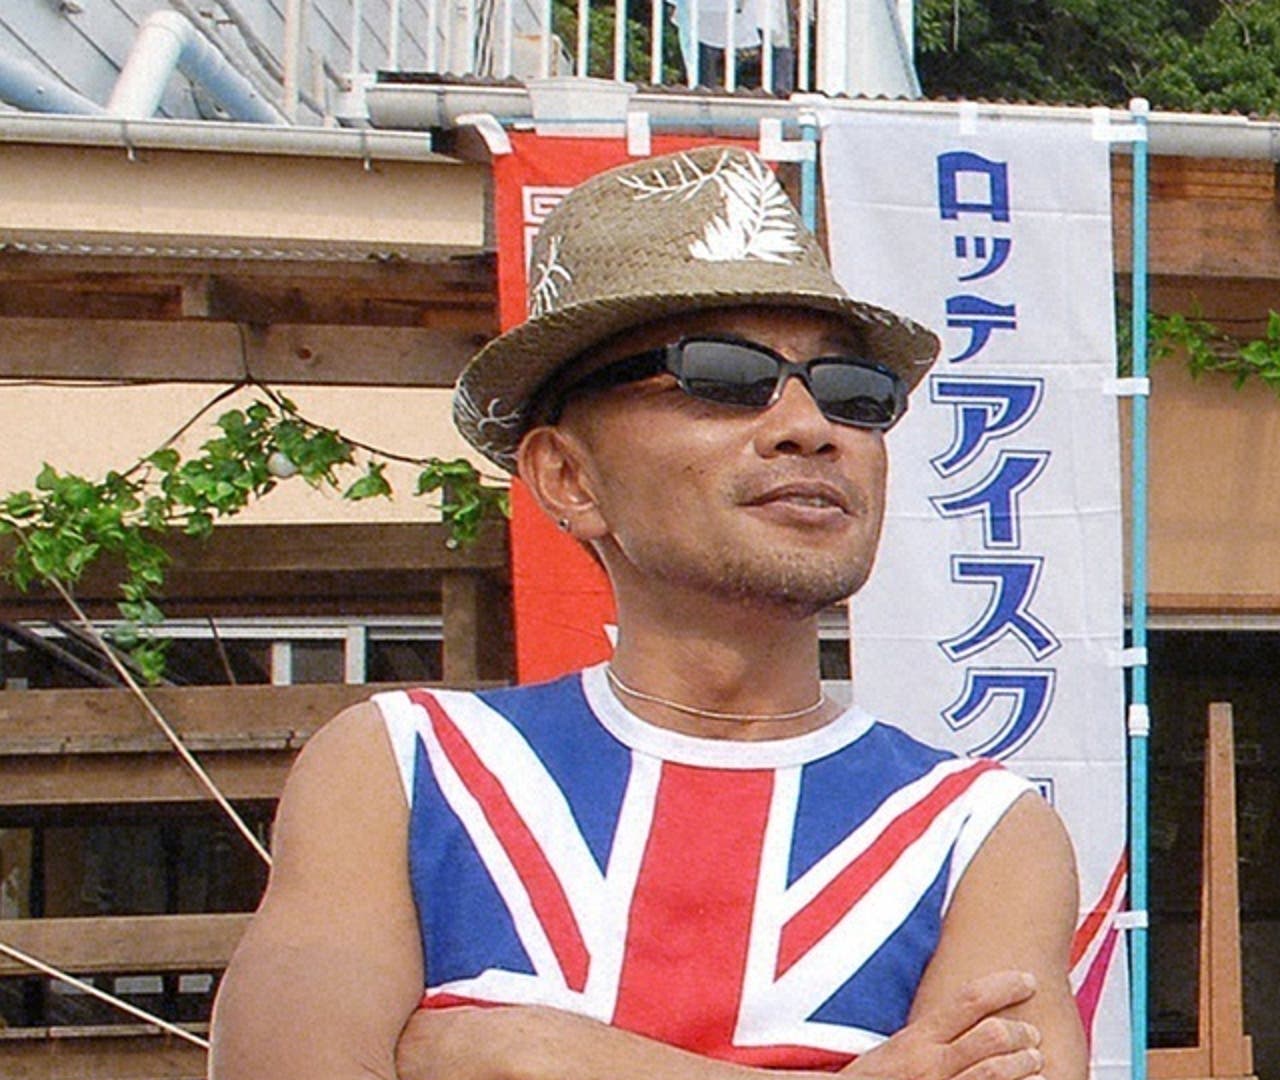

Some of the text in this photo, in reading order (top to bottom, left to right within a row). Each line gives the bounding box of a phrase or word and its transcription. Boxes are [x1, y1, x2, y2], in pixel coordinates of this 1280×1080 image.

[929, 150, 1063, 806] ロッテアイスク
